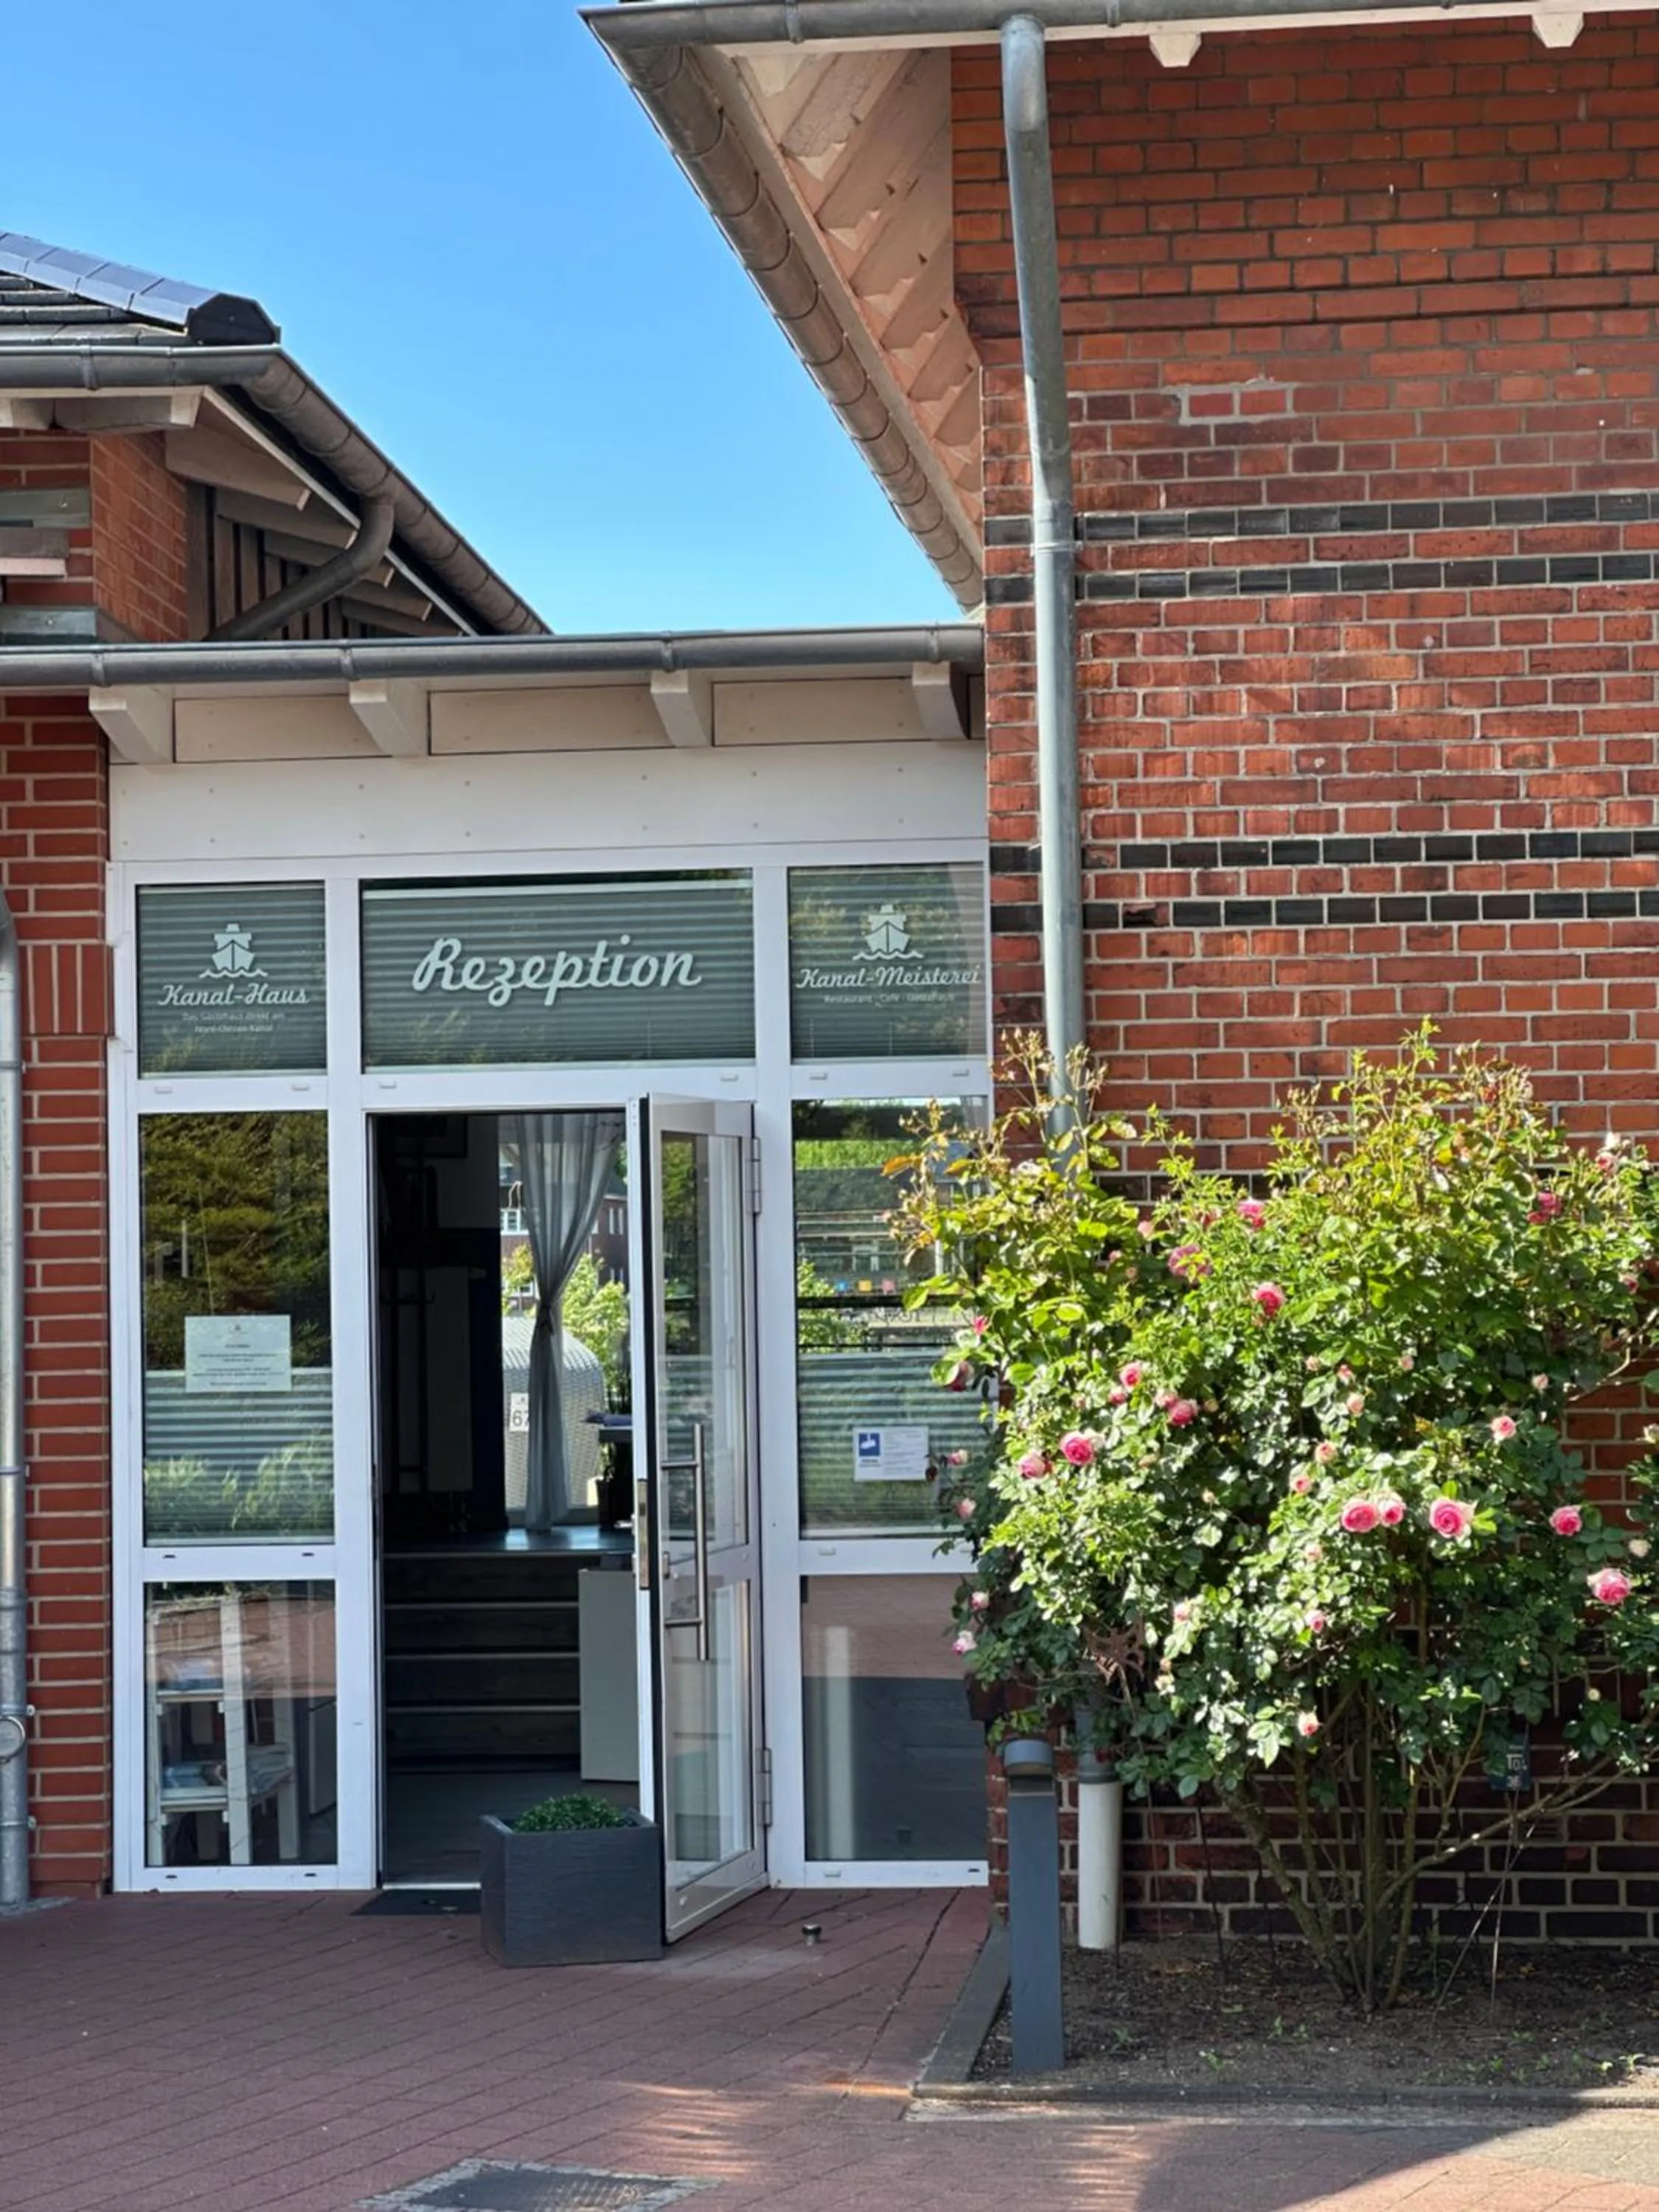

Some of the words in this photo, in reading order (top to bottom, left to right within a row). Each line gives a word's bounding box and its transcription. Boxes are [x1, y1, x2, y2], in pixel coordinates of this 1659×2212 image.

[412, 934, 702, 1007] Rezeption
[796, 966, 981, 989] Kanal-Meisterei
[158, 983, 310, 1006] Kanal-Haus
